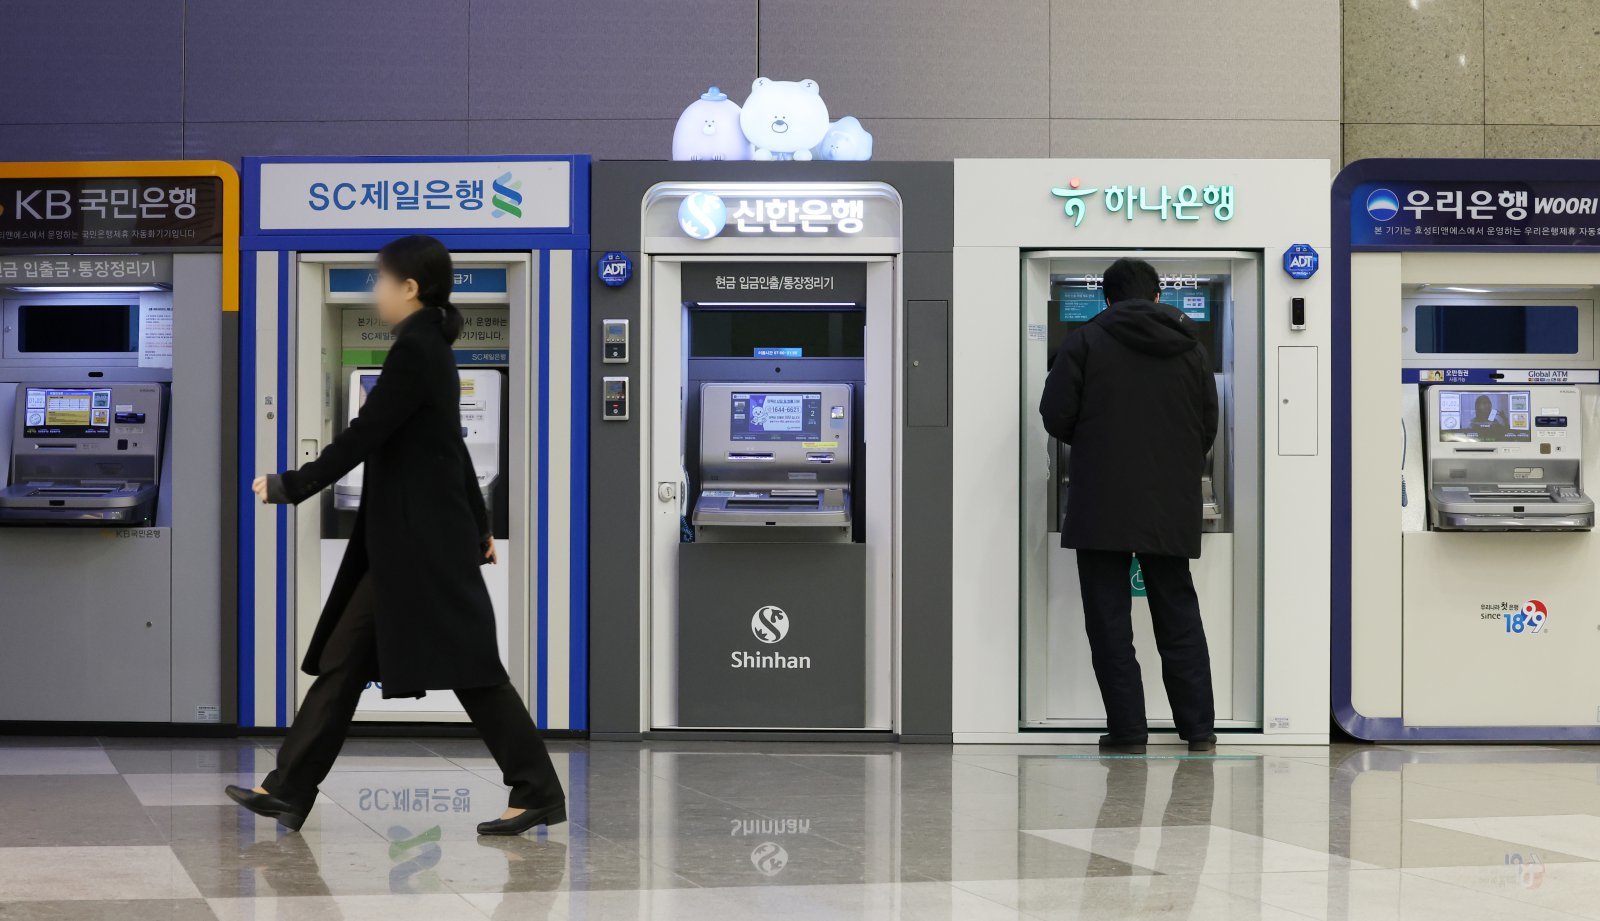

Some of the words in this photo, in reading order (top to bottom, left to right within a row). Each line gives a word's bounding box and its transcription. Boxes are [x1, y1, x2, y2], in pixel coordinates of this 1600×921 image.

[308, 178, 485, 211] SC제일은행
[1104, 184, 1236, 222] 하나은행
[1403, 190, 1529, 221] 우리은행
[1534, 197, 1599, 215] WOORI
[732, 198, 865, 233] 신한은행
[47, 230, 79, 240] 운영하는
[82, 230, 129, 239] 국민은행제휴
[131, 229, 196, 239] 자동화기기입니다
[1374, 226, 1383, 235] 본
[1386, 226, 1412, 235] 기기는
[1414, 226, 1484, 236] 효성티앤에스에서
[1487, 226, 1521, 236] 운영하는
[1524, 226, 1576, 236] 우리은행제휴
[1289, 255, 1312, 268] ADT
[0, 261, 18, 278] 금
[602, 263, 626, 276] ADT
[715, 275, 736, 290] 현금
[739, 275, 834, 291] 입금인출/통장정리기
[476, 316, 508, 327] 운영하는
[361, 331, 397, 341] SC제일은
[461, 331, 504, 341] 기기입니다.
[472, 353, 507, 361] SC제일은행
[1528, 370, 1551, 378] Global
[1552, 370, 1568, 378] ATM
[1501, 602, 1508, 610] 첫
[1480, 612, 1501, 620] since
[731, 651, 811, 668] Shinhan
